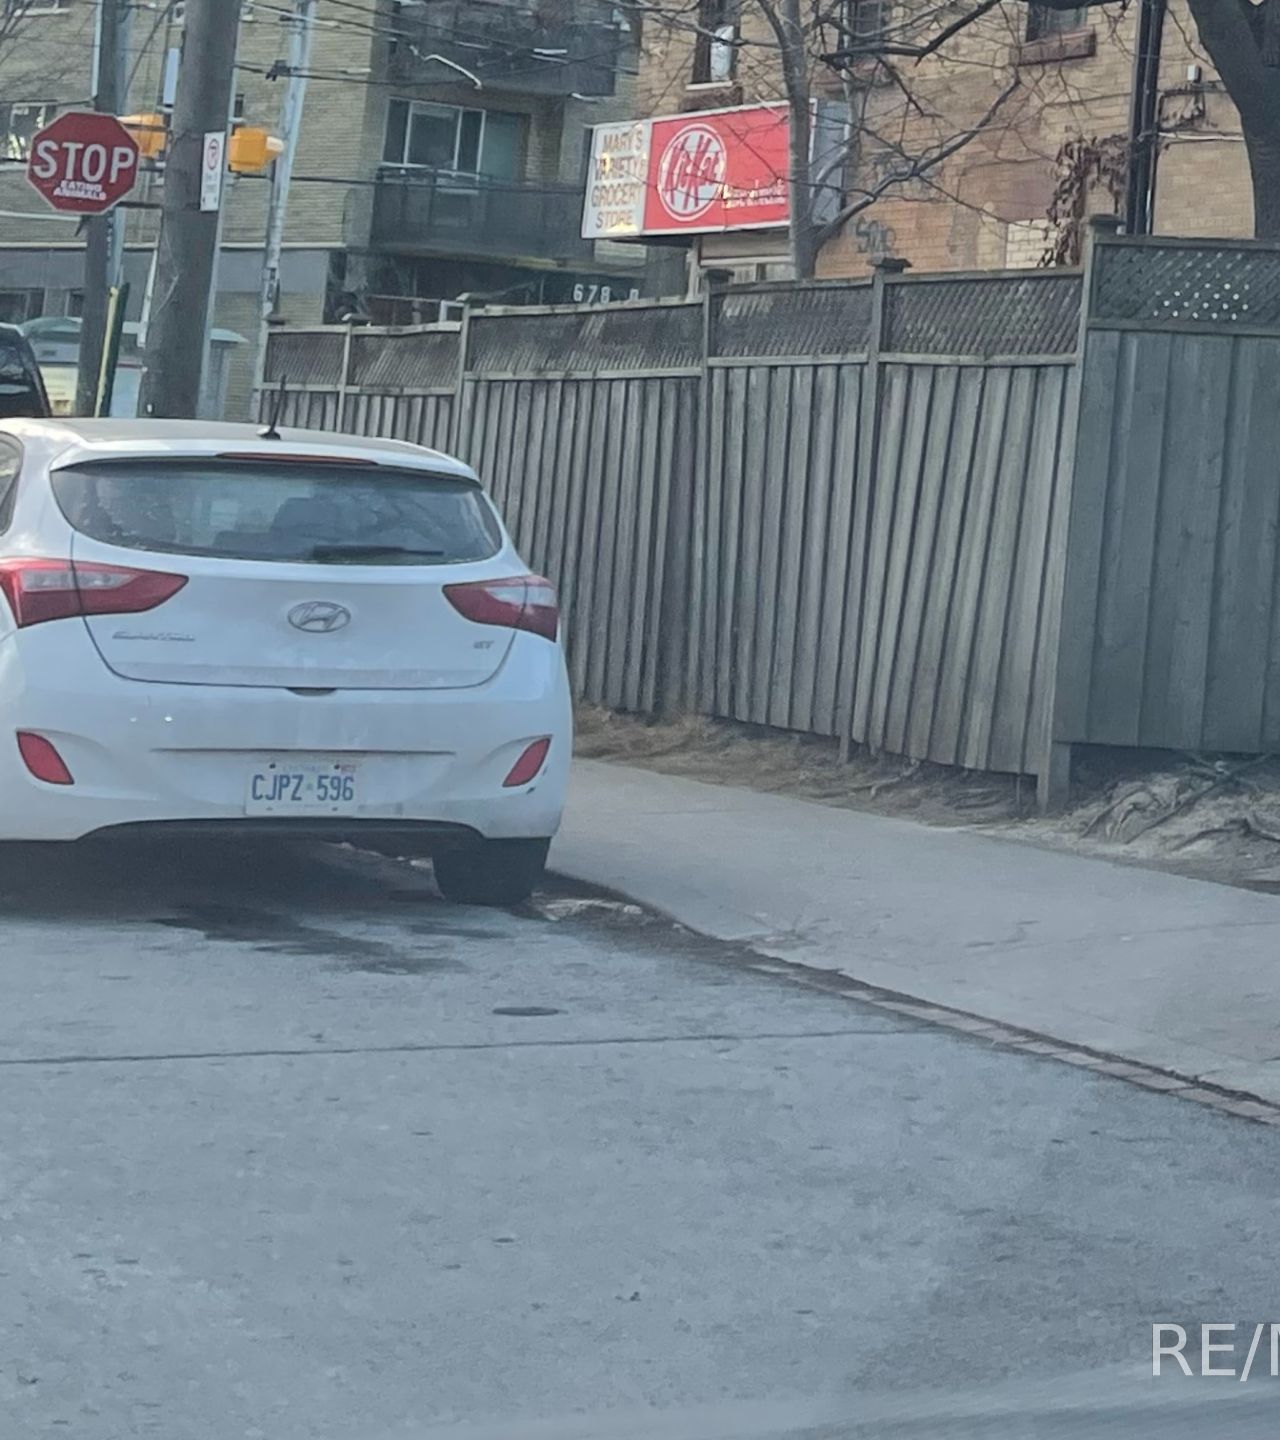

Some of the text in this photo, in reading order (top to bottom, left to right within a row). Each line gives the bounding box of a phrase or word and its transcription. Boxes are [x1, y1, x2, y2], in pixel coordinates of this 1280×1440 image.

[32, 140, 135, 184] STOP
[591, 182, 642, 207] GROCERY
[595, 210, 634, 229] STORE
[573, 283, 611, 304] 678
[252, 774, 354, 801] CJPZ 596
